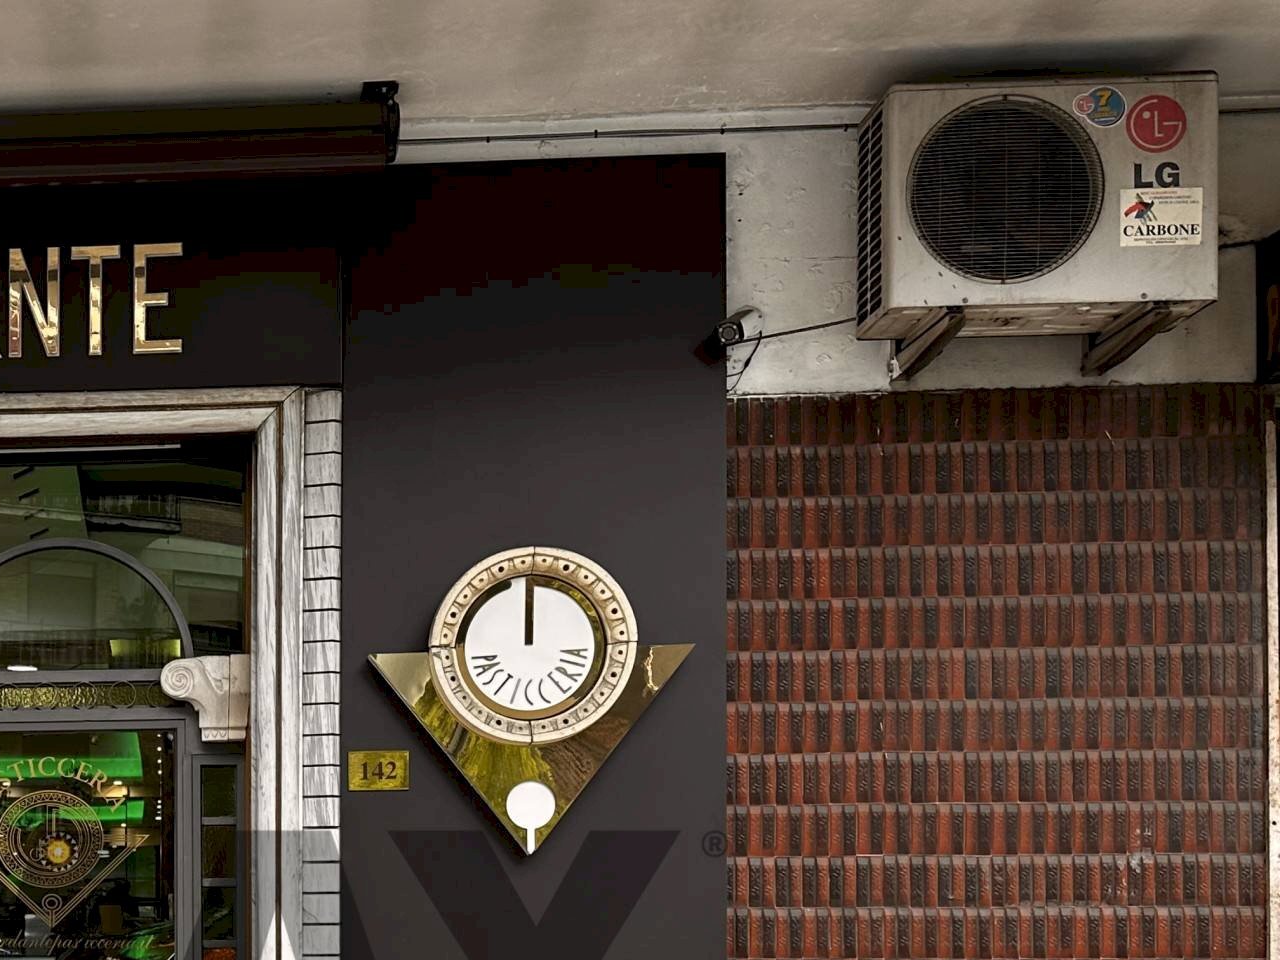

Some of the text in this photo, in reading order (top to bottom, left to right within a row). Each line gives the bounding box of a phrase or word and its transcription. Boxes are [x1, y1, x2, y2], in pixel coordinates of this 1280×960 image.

[1133, 161, 1181, 189] LG
[1122, 223, 1200, 238] CARBONE
[470, 647, 589, 706] PASTICCERIA
[358, 760, 398, 781] 142
